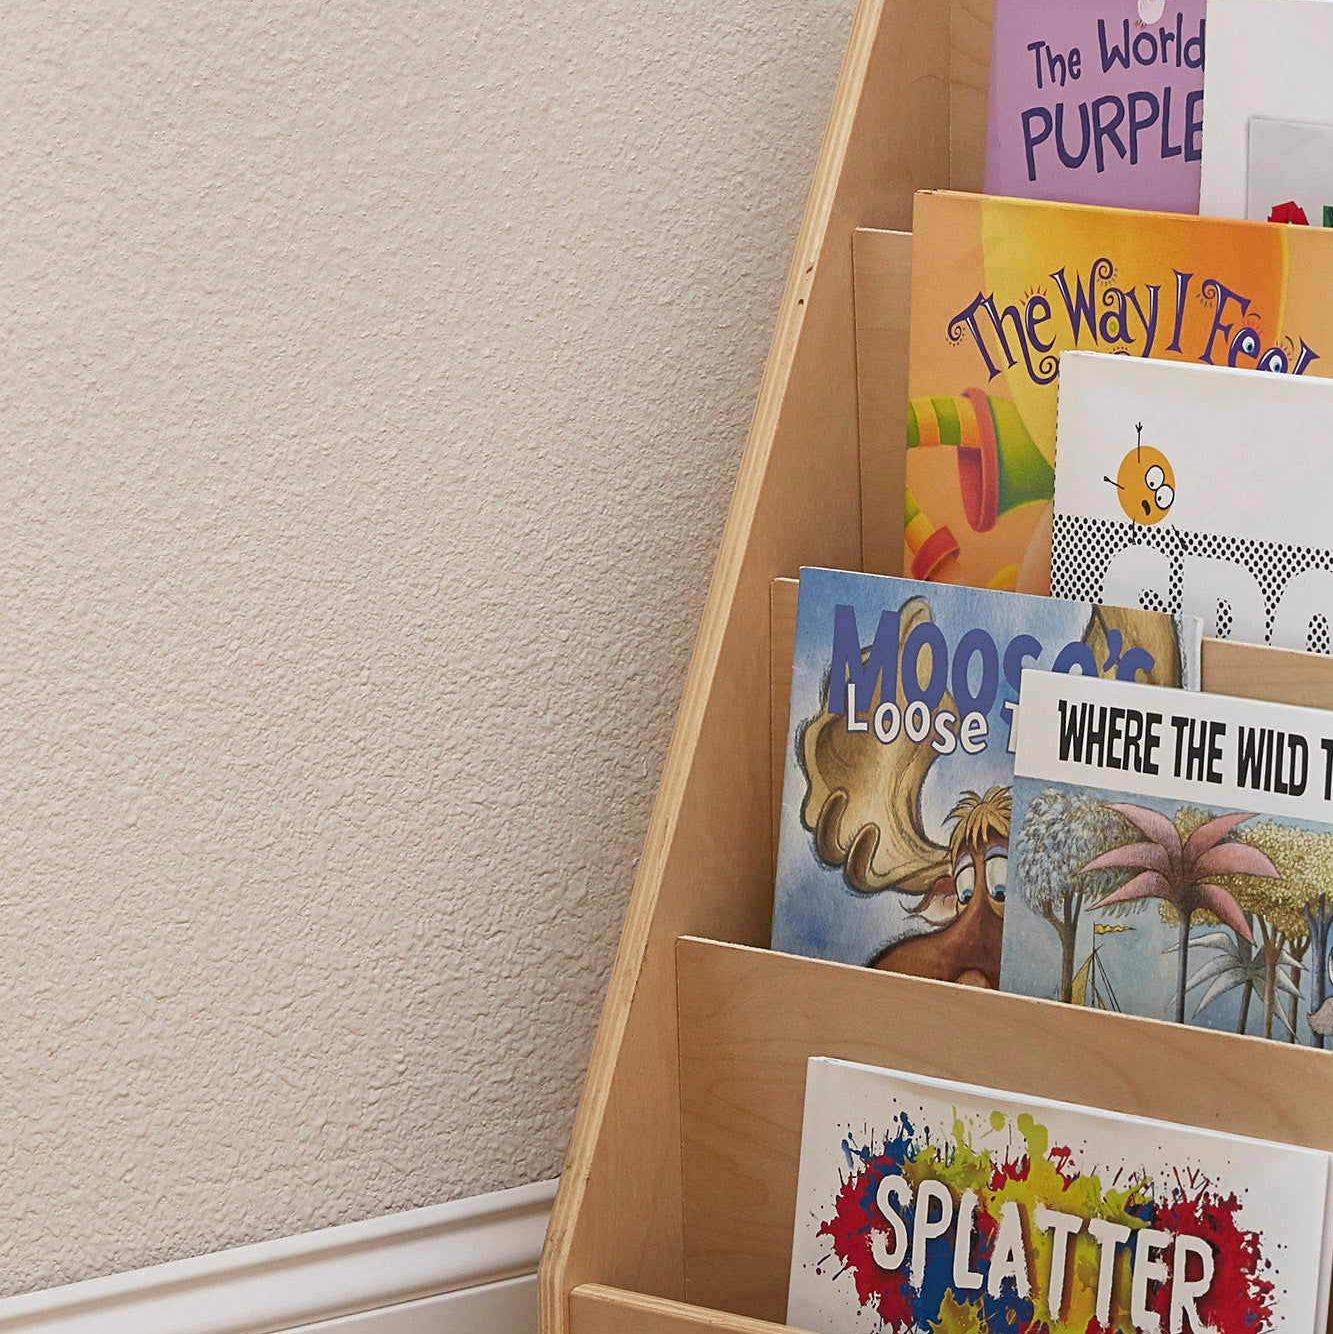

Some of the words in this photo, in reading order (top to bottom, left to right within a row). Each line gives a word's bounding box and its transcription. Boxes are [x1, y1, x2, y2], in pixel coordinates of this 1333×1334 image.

[1027, 40, 1081, 89] The
[947, 289, 1058, 385] The
[1049, 257, 1161, 357] Way
[1166, 268, 1193, 353] I
[847, 683, 990, 756] Loose
[1058, 699, 1162, 774] WHERE
[1170, 717, 1223, 784] THE
[1235, 727, 1310, 798] WILD
